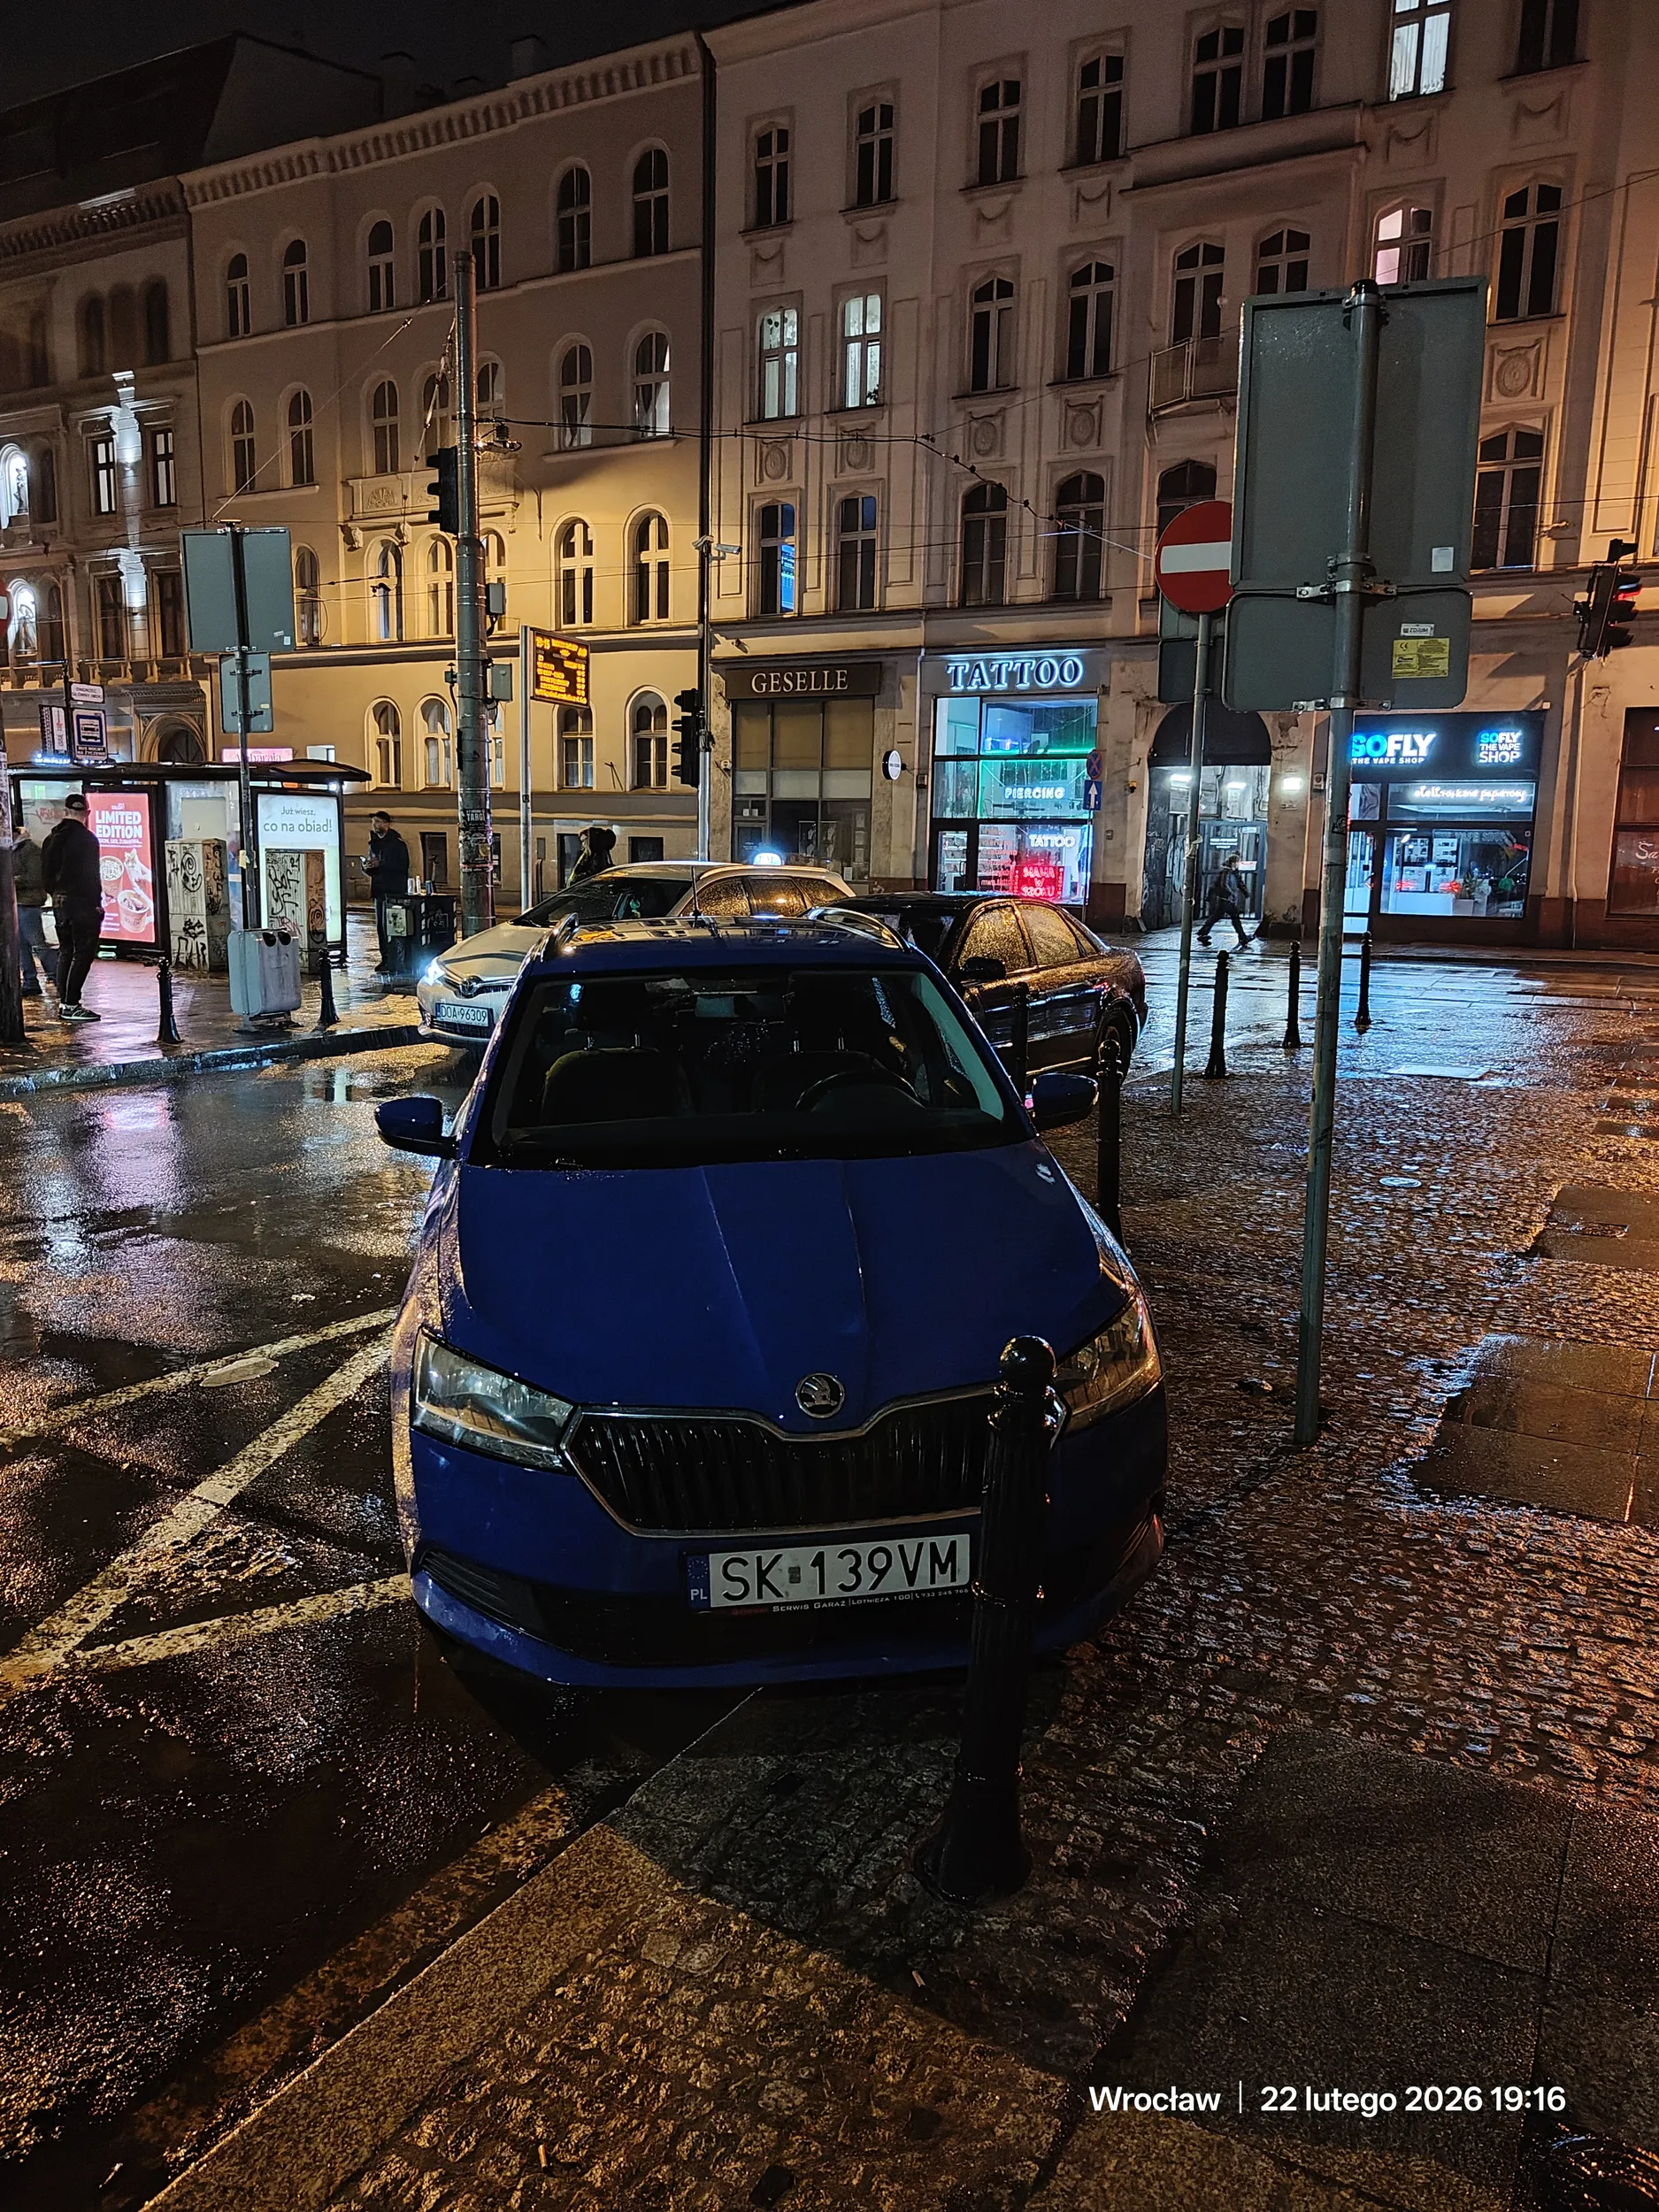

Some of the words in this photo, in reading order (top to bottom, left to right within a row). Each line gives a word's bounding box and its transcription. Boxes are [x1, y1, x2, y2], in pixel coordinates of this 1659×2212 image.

[946, 657, 1084, 692] TATTOO
[750, 670, 849, 695] GESELLE
[1351, 731, 1437, 757] SOFLY
[1480, 731, 1522, 743] SOFLY
[1499, 742, 1521, 751] VAPE
[1479, 751, 1521, 764] SHOP
[1004, 787, 1065, 799] PIERCING
[95, 810, 142, 825] LIMITED
[281, 806, 294, 816] Już
[295, 807, 316, 817] wiesz,
[96, 825, 142, 839] EDITION
[263, 822, 278, 833] co
[280, 822, 295, 833] na
[297, 818, 333, 833] obiad!
[1029, 834, 1076, 848] TATTOO
[441, 1005, 458, 1018] DOA
[460, 1010, 488, 1023] 96309
[721, 1553, 784, 1601] SK
[810, 1540, 957, 1595] 139VM
[690, 1589, 707, 1601] PL
[772, 1602, 810, 1613] SERWIS
[813, 1600, 846, 1609] GARAŻ
